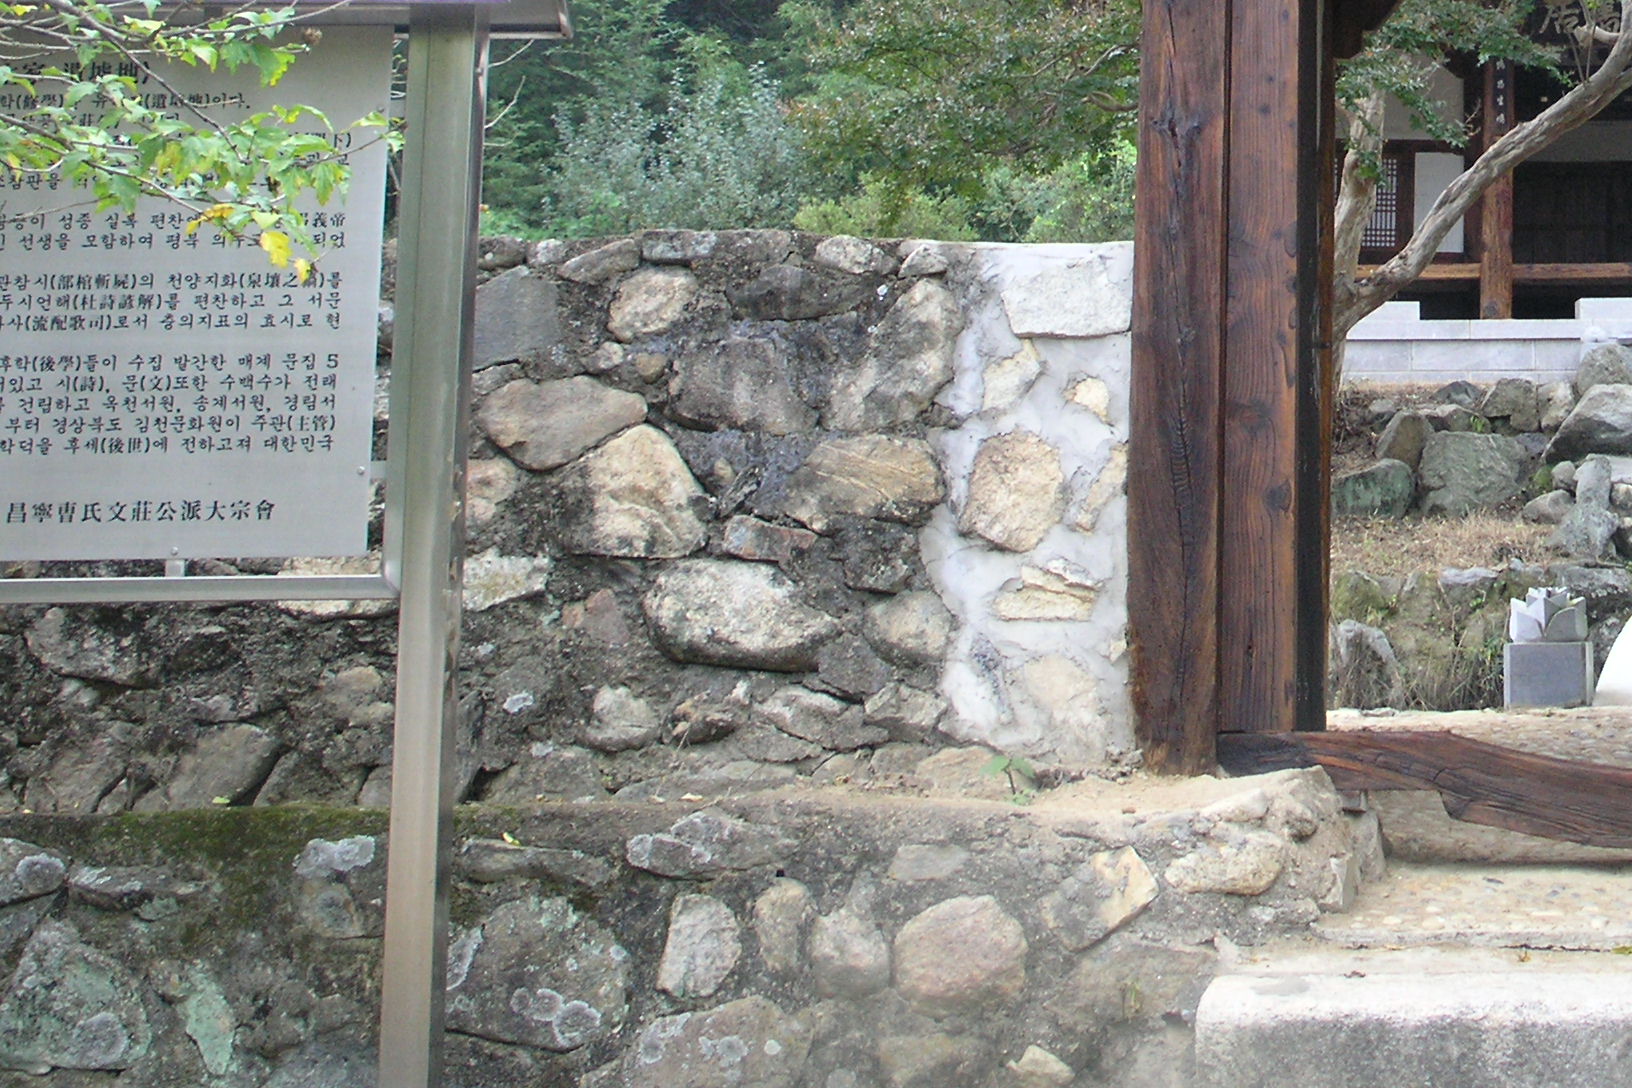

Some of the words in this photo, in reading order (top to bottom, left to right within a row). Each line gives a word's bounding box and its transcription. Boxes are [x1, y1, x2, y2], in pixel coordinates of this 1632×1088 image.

[60, 213, 91, 230] 성종
[20, 233, 71, 250] 선생을
[82, 232, 154, 250] 모함하여
[166, 232, 199, 249] 평북
[194, 292, 266, 310] 편찬하고
[278, 294, 294, 307] 그
[308, 291, 341, 309] 서문
[160, 312, 249, 330] 충의지표의
[260, 312, 313, 328] 효시로
[326, 311, 341, 330] 현
[128, 354, 163, 372] 수집
[173, 353, 227, 372] 발간한
[238, 353, 271, 370] 매계
[282, 352, 316, 371] 문집
[326, 353, 340, 369] 5
[220, 373, 291, 391] 수백수가
[304, 372, 337, 391] 전래
[19, 395, 91, 414] 건립하고
[284, 393, 336, 412] 경림서
[5, 416, 41, 434] 부터
[53, 415, 123, 435] 경상북도
[135, 415, 240, 435] 김천문화원이
[182, 435, 252, 455] 전하고져
[264, 434, 334, 454] 대한민국
